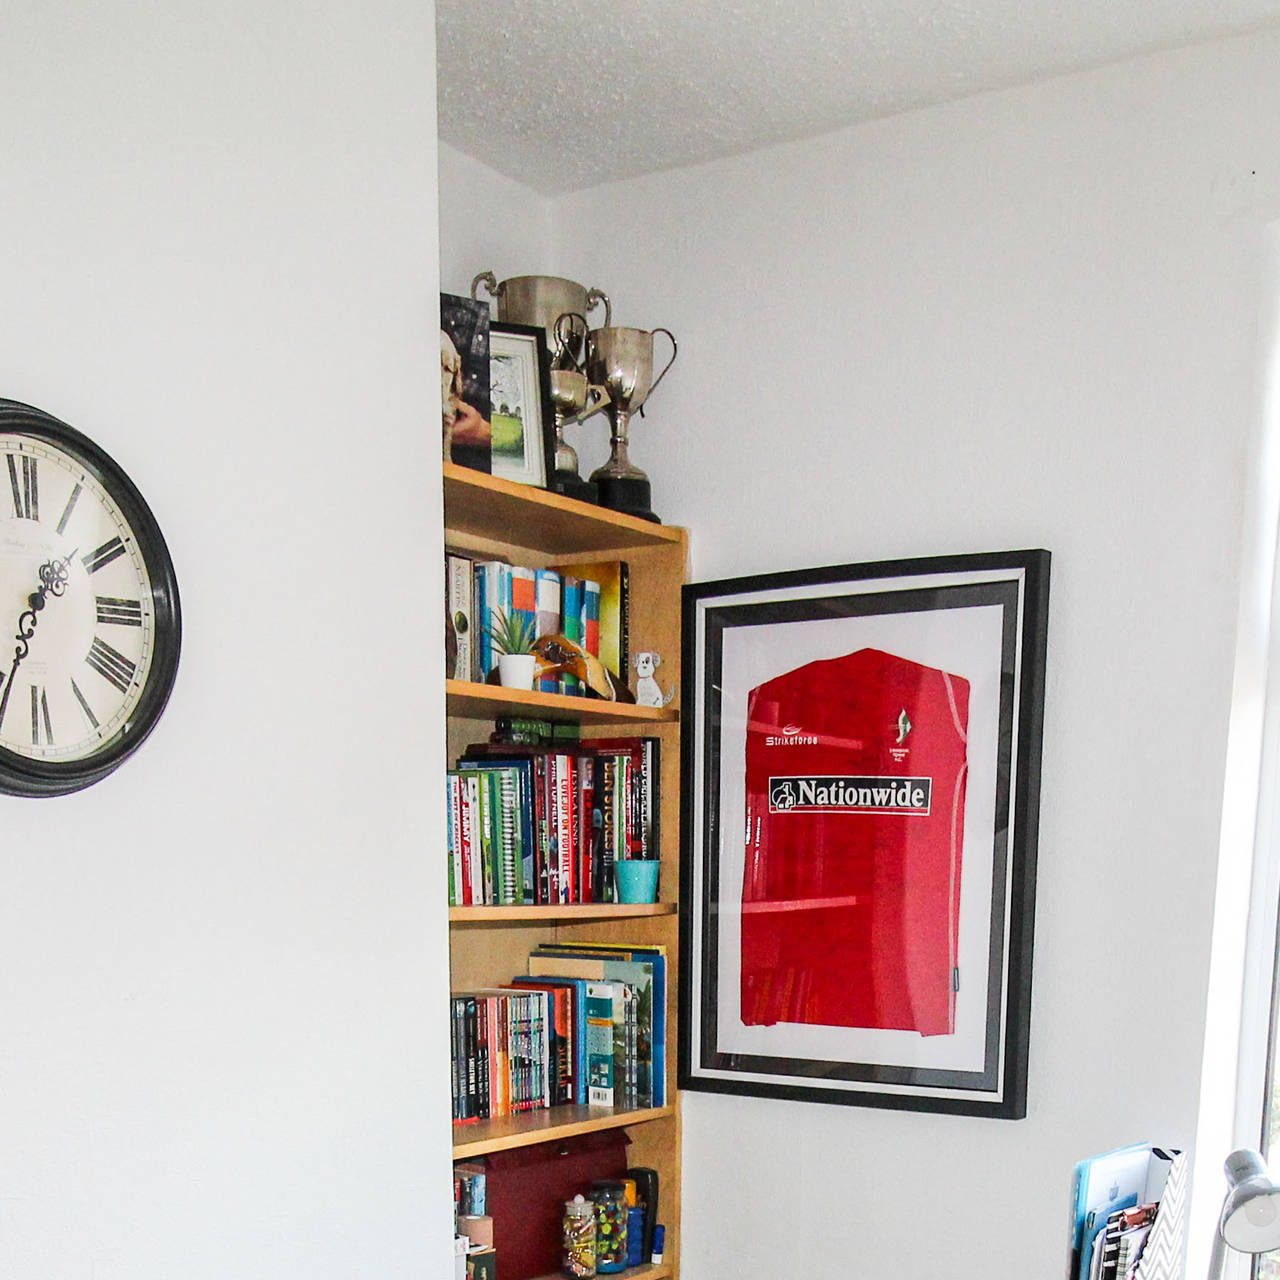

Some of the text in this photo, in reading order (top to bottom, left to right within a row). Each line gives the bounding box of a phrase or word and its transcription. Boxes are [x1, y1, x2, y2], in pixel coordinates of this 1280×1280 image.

[95, 596, 142, 627] III
[604, 762, 614, 791] BEN
[797, 780, 925, 807] Nationwide
[462, 804, 470, 843] JIMMY
[604, 795, 614, 850] STOKES
